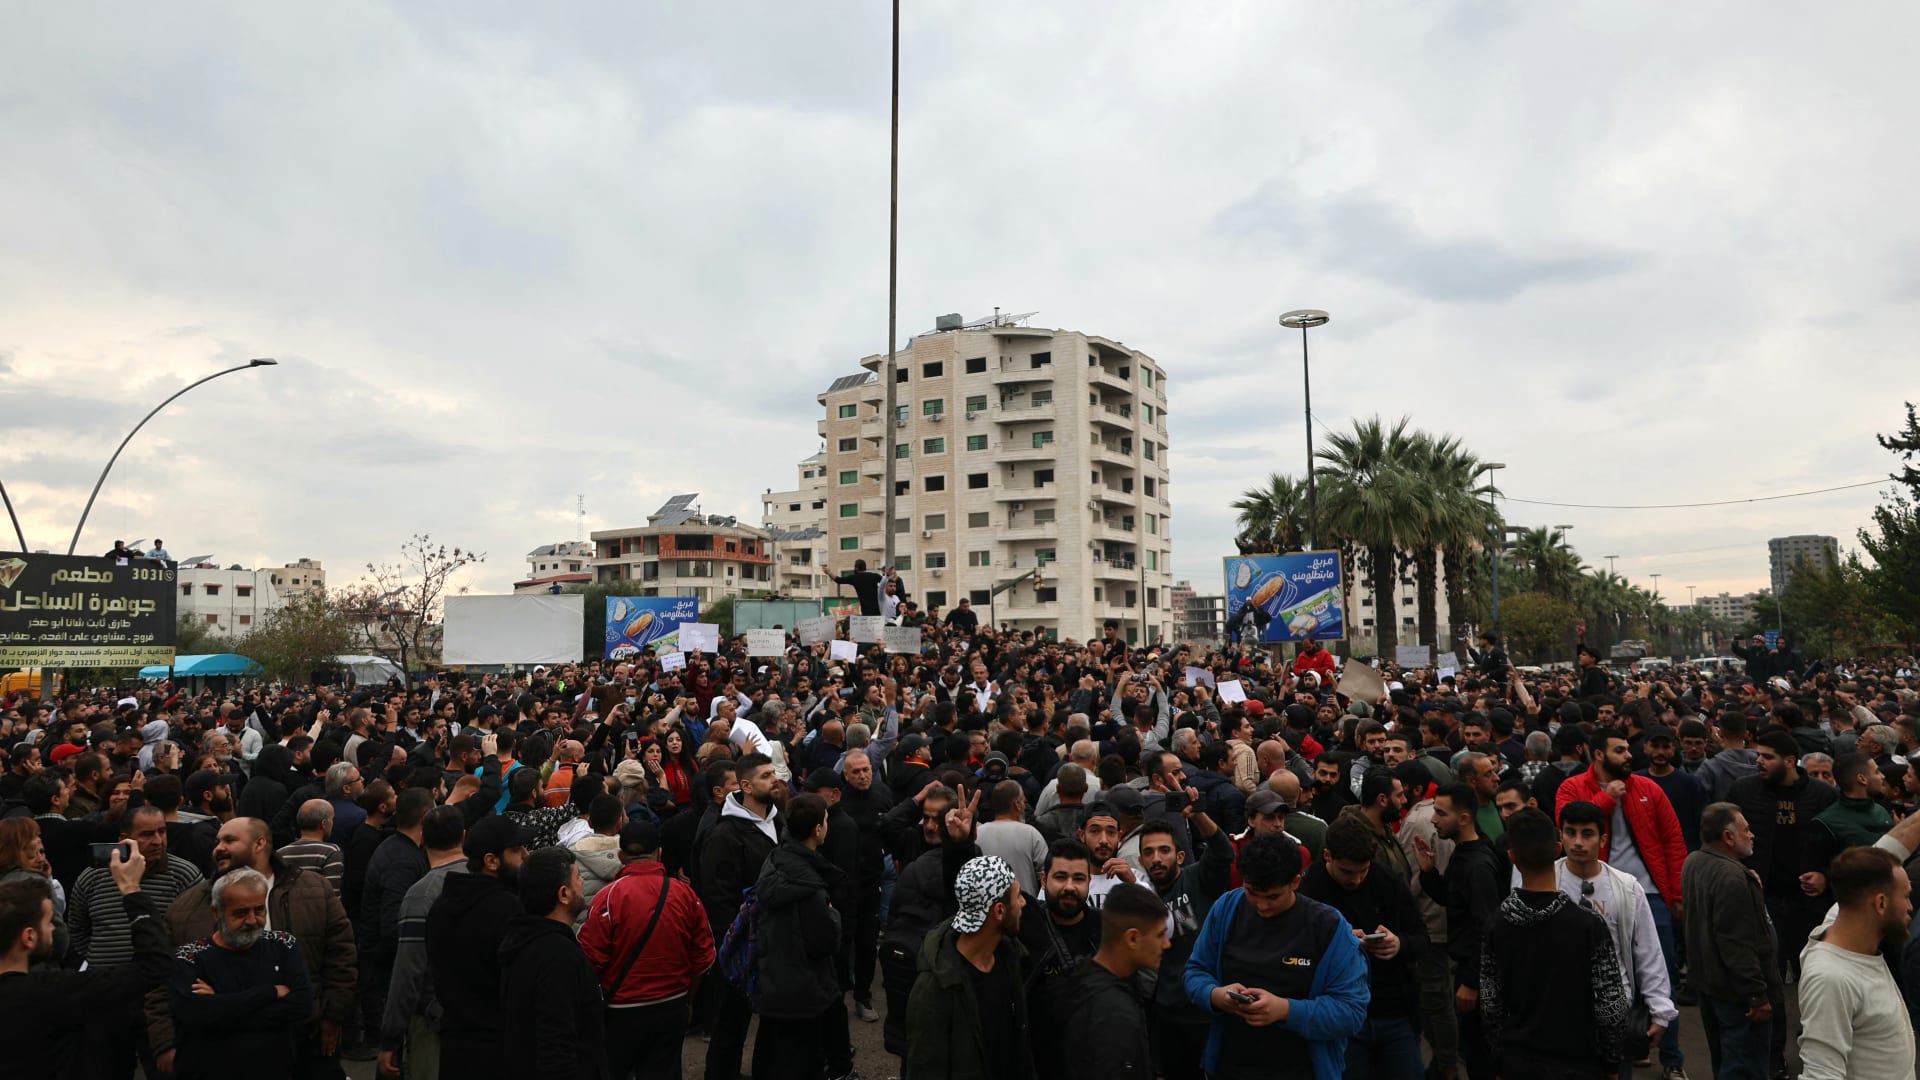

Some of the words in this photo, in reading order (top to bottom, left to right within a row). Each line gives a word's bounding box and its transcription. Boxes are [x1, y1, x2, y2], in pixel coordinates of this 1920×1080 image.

[50, 566, 114, 585] مطعم
[132, 568, 163, 581] 3031
[0, 590, 83, 611] الساحل
[89, 592, 156, 618] جوهرة
[28, 617, 49, 630] صخر
[50, 616, 64, 629] أبو
[86, 618, 106, 629] ثابت
[108, 619, 131, 630] طارق
[38, 631, 67, 643] الفحم
[69, 631, 90, 642] على
[91, 632, 126, 644] مشاوي
[132, 632, 154, 644] فروج
[1298, 958, 1311, 966] GLS
